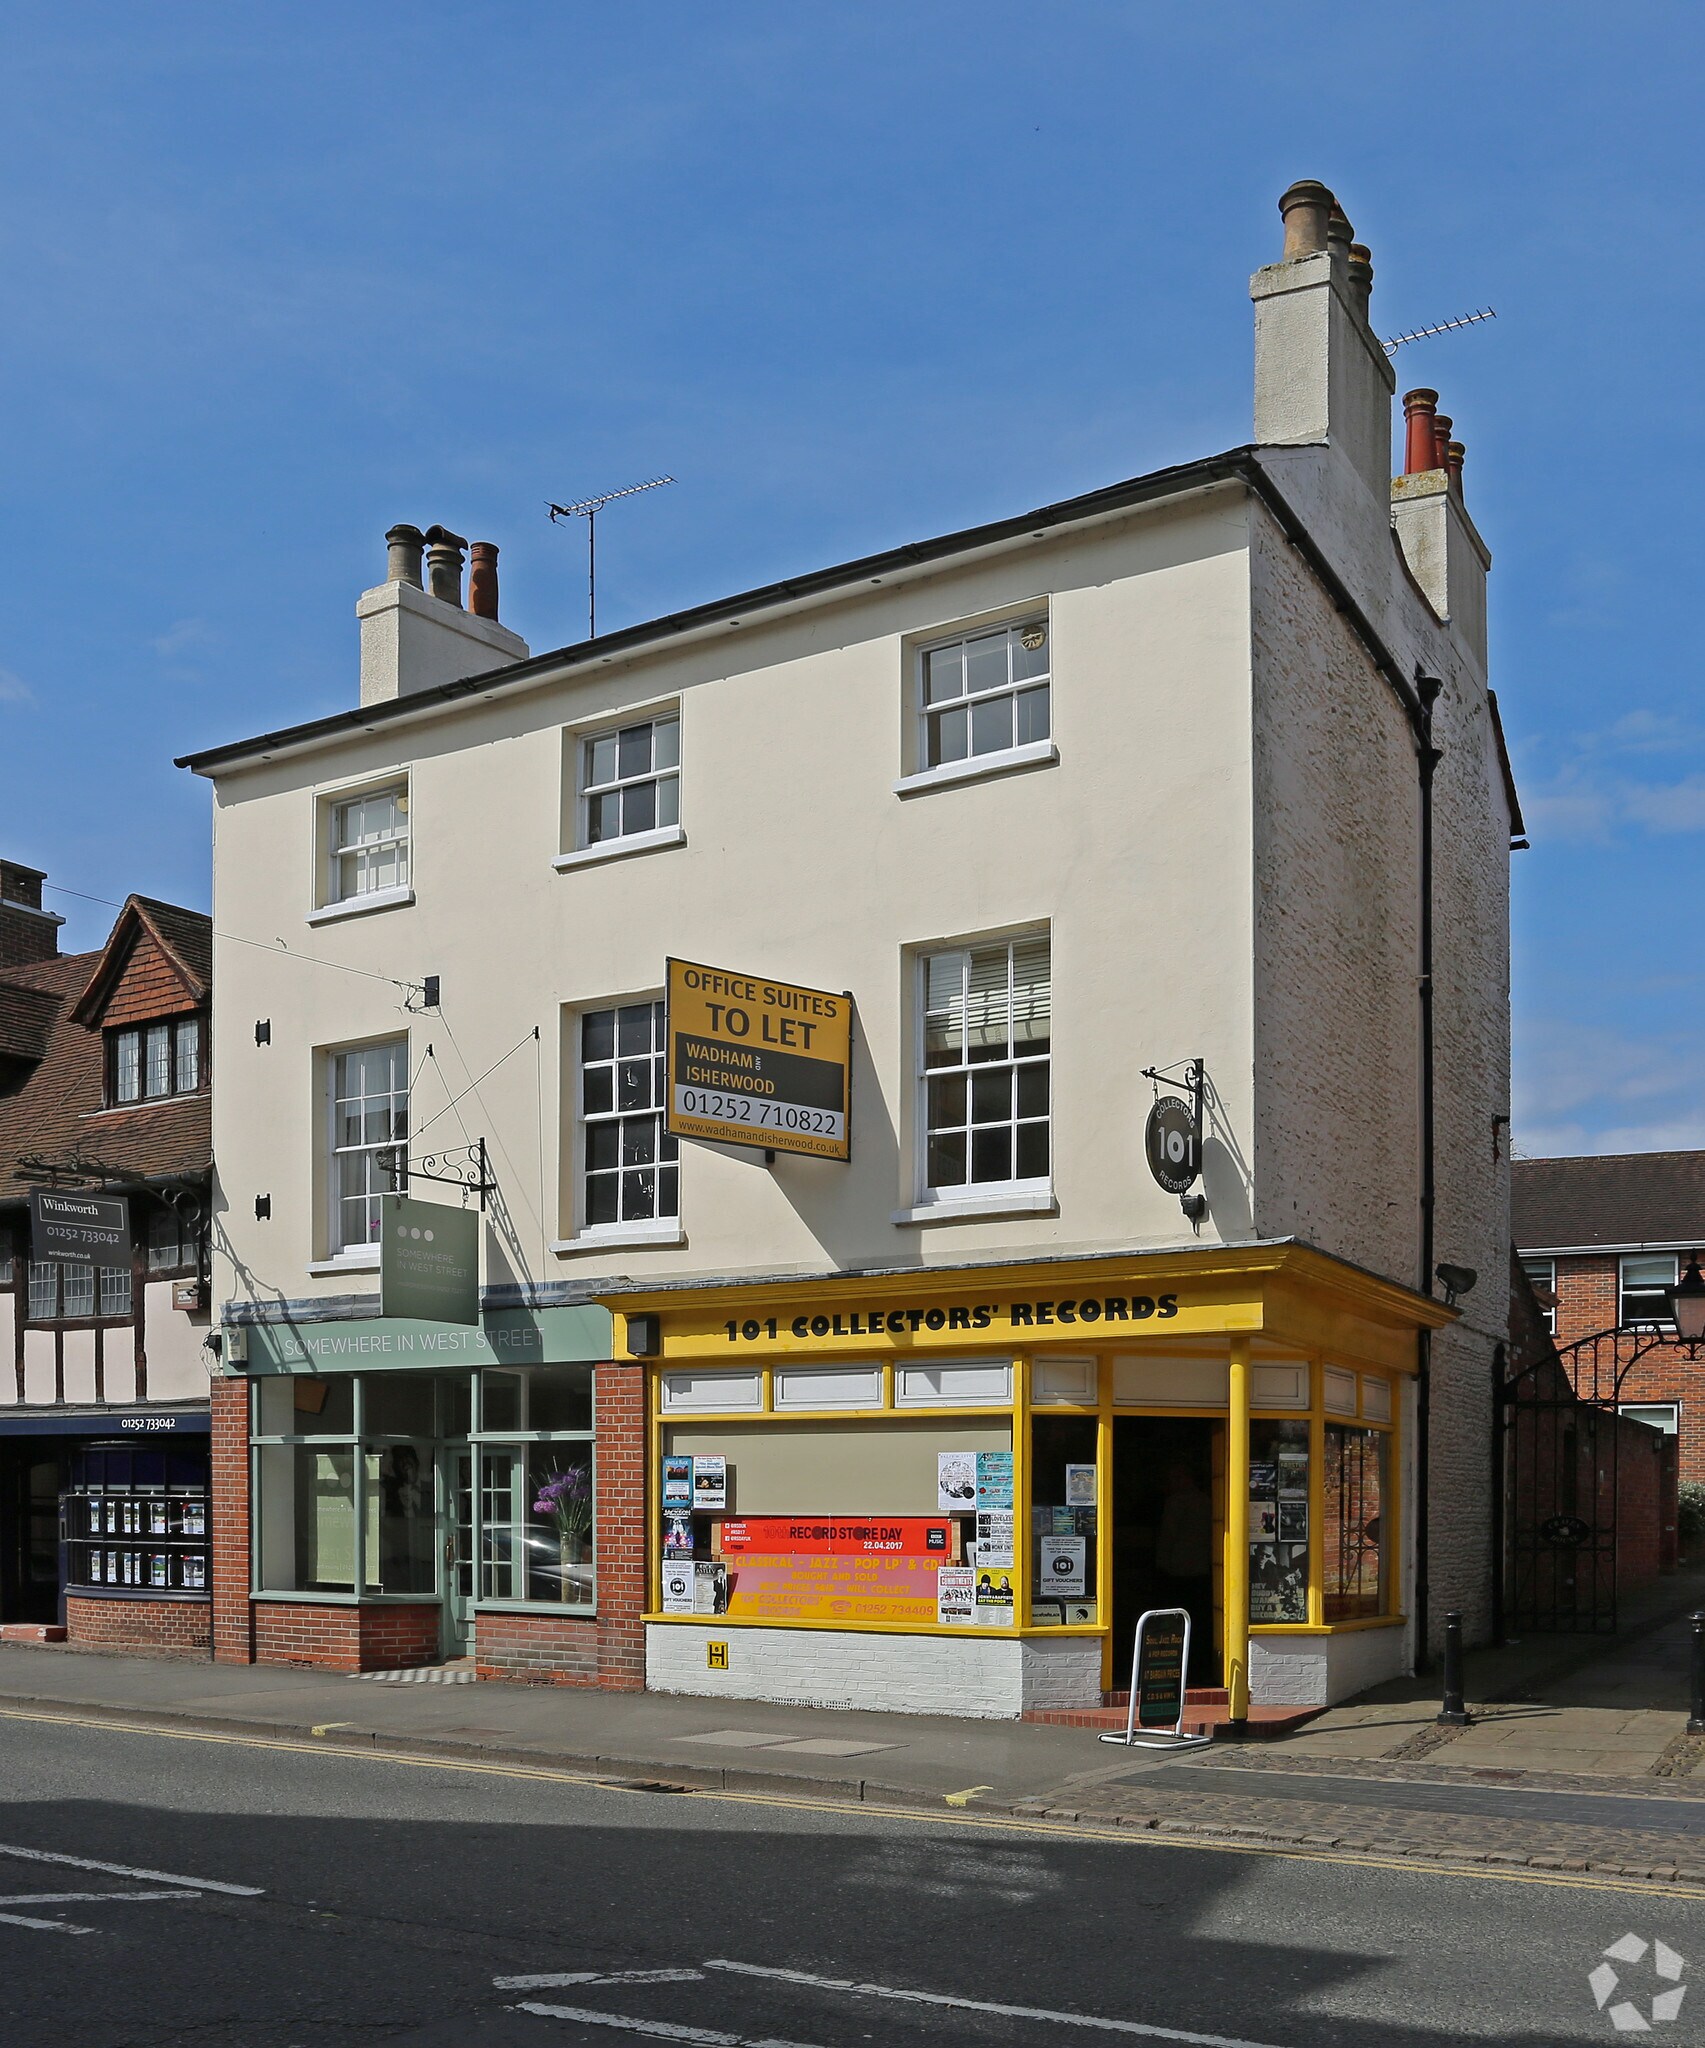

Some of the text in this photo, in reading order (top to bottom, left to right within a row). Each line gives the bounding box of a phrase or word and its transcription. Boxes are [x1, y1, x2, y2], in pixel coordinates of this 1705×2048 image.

[684, 969, 837, 1018] OFFICE SUITES
[705, 1002, 817, 1050] TO LET
[686, 1042, 753, 1069] WADHAM
[686, 1065, 775, 1094] ISHERWOOD
[683, 1090, 836, 1135] 01252 710822
[1156, 1099, 1195, 1129] COLLECTORS
[678, 1120, 842, 1156] www.wadhamandisherwood.co.uk
[1158, 1126, 1193, 1167] 101
[1158, 1170, 1192, 1190] RECORDS
[43, 1198, 98, 1215] Winkworth
[46, 1226, 119, 1245] 01252 733042
[48, 1250, 91, 1259] winkworth.co.uk
[397, 1248, 454, 1264] SOMEWHERE
[397, 1261, 468, 1278] IN WEST STREET
[723, 1294, 1179, 1341] 101 COLLECTORS' RECORDS
[285, 1328, 545, 1355] SOMEWHERE IN WEST STREET
[121, 1418, 175, 1430] 01252 733042
[790, 1526, 837, 1540] RECORD
[838, 1526, 878, 1540] STORE
[880, 1527, 903, 1540] DAY
[863, 1541, 903, 1550] 22.04.2017
[735, 1556, 794, 1569] CLASSICAL
[809, 1557, 838, 1569] JAZZ
[854, 1557, 880, 1570] POP
[907, 1558, 917, 1570] &
[1055, 1562, 1071, 1570] 101
[791, 1571, 878, 1582] BOUGHT AND SOLD
[671, 1583, 684, 1591] 101
[847, 1584, 867, 1594] WILL
[870, 1585, 911, 1595] COLLECT
[855, 1603, 887, 1614] 01252
[891, 1604, 934, 1616] 734409
[709, 1644, 724, 1666] H
